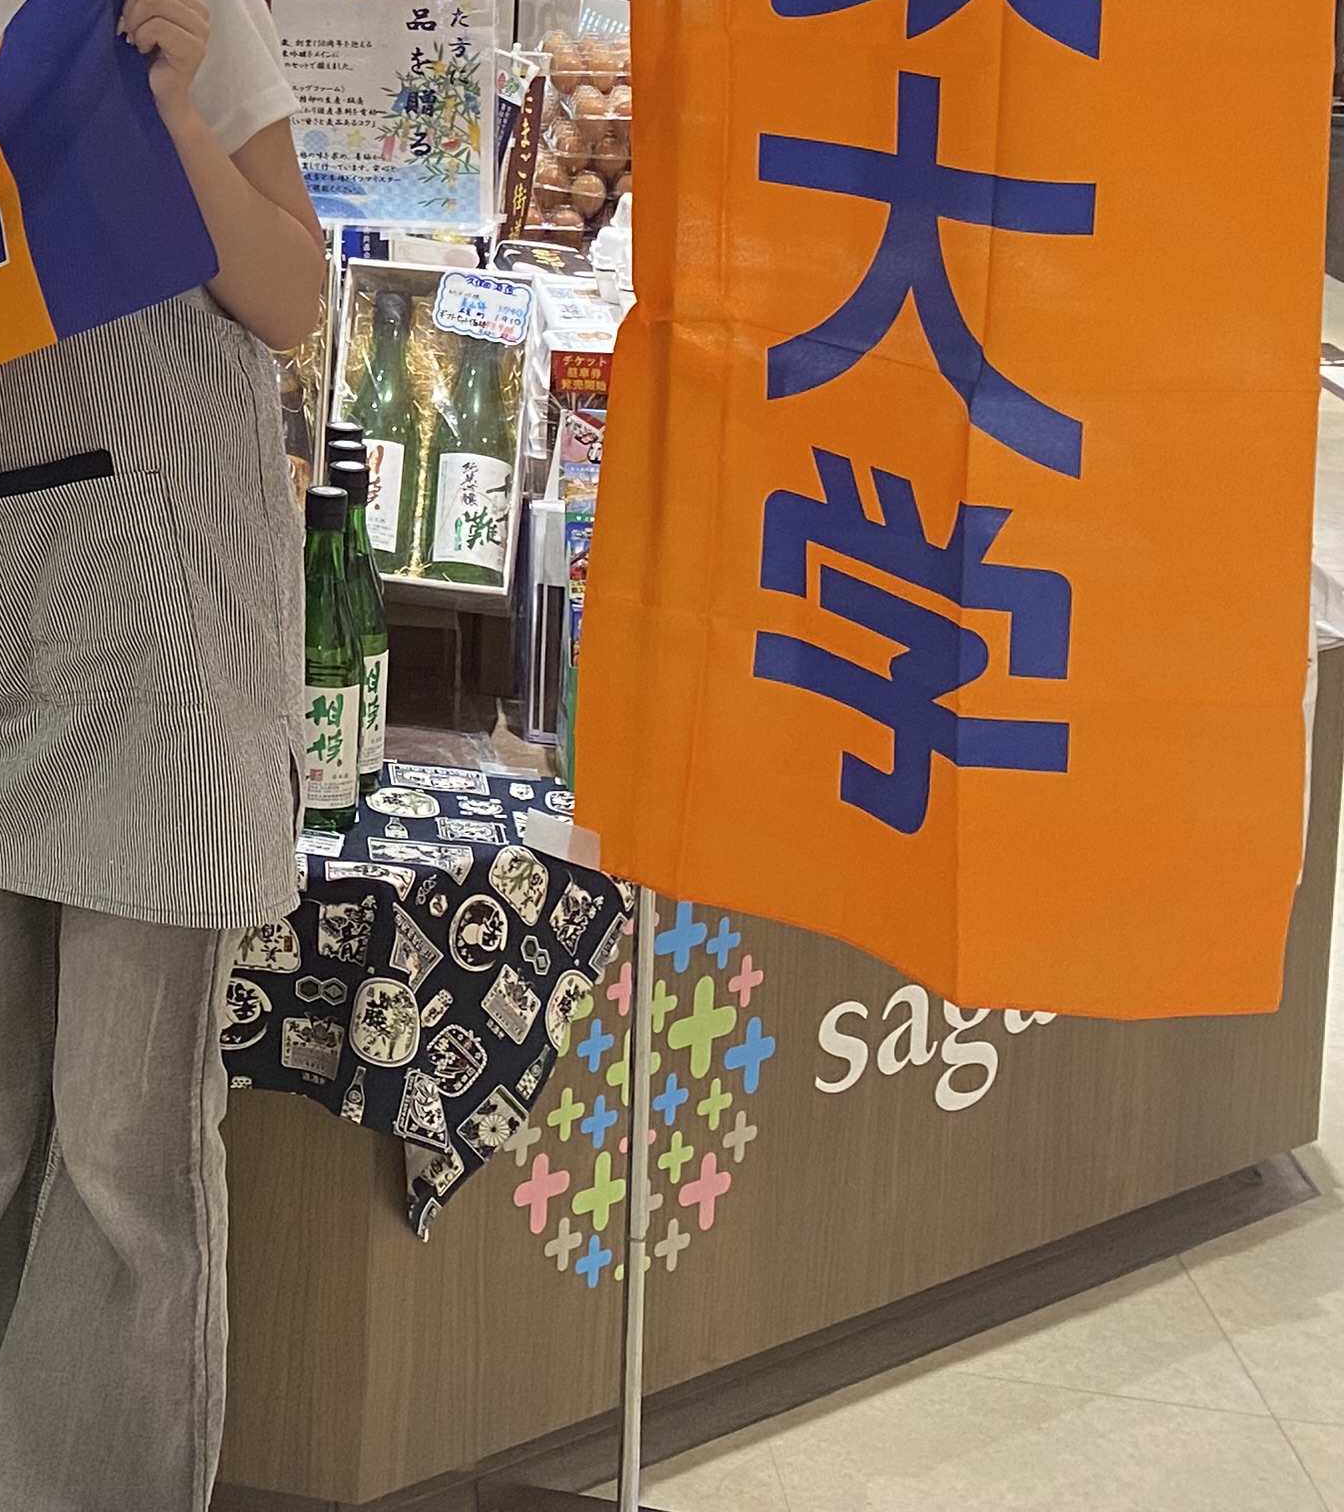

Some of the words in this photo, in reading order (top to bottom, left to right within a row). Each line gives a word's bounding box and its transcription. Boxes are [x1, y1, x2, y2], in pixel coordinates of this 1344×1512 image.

[562, 355, 608, 367] チケット
[304, 692, 344, 768] 相模
